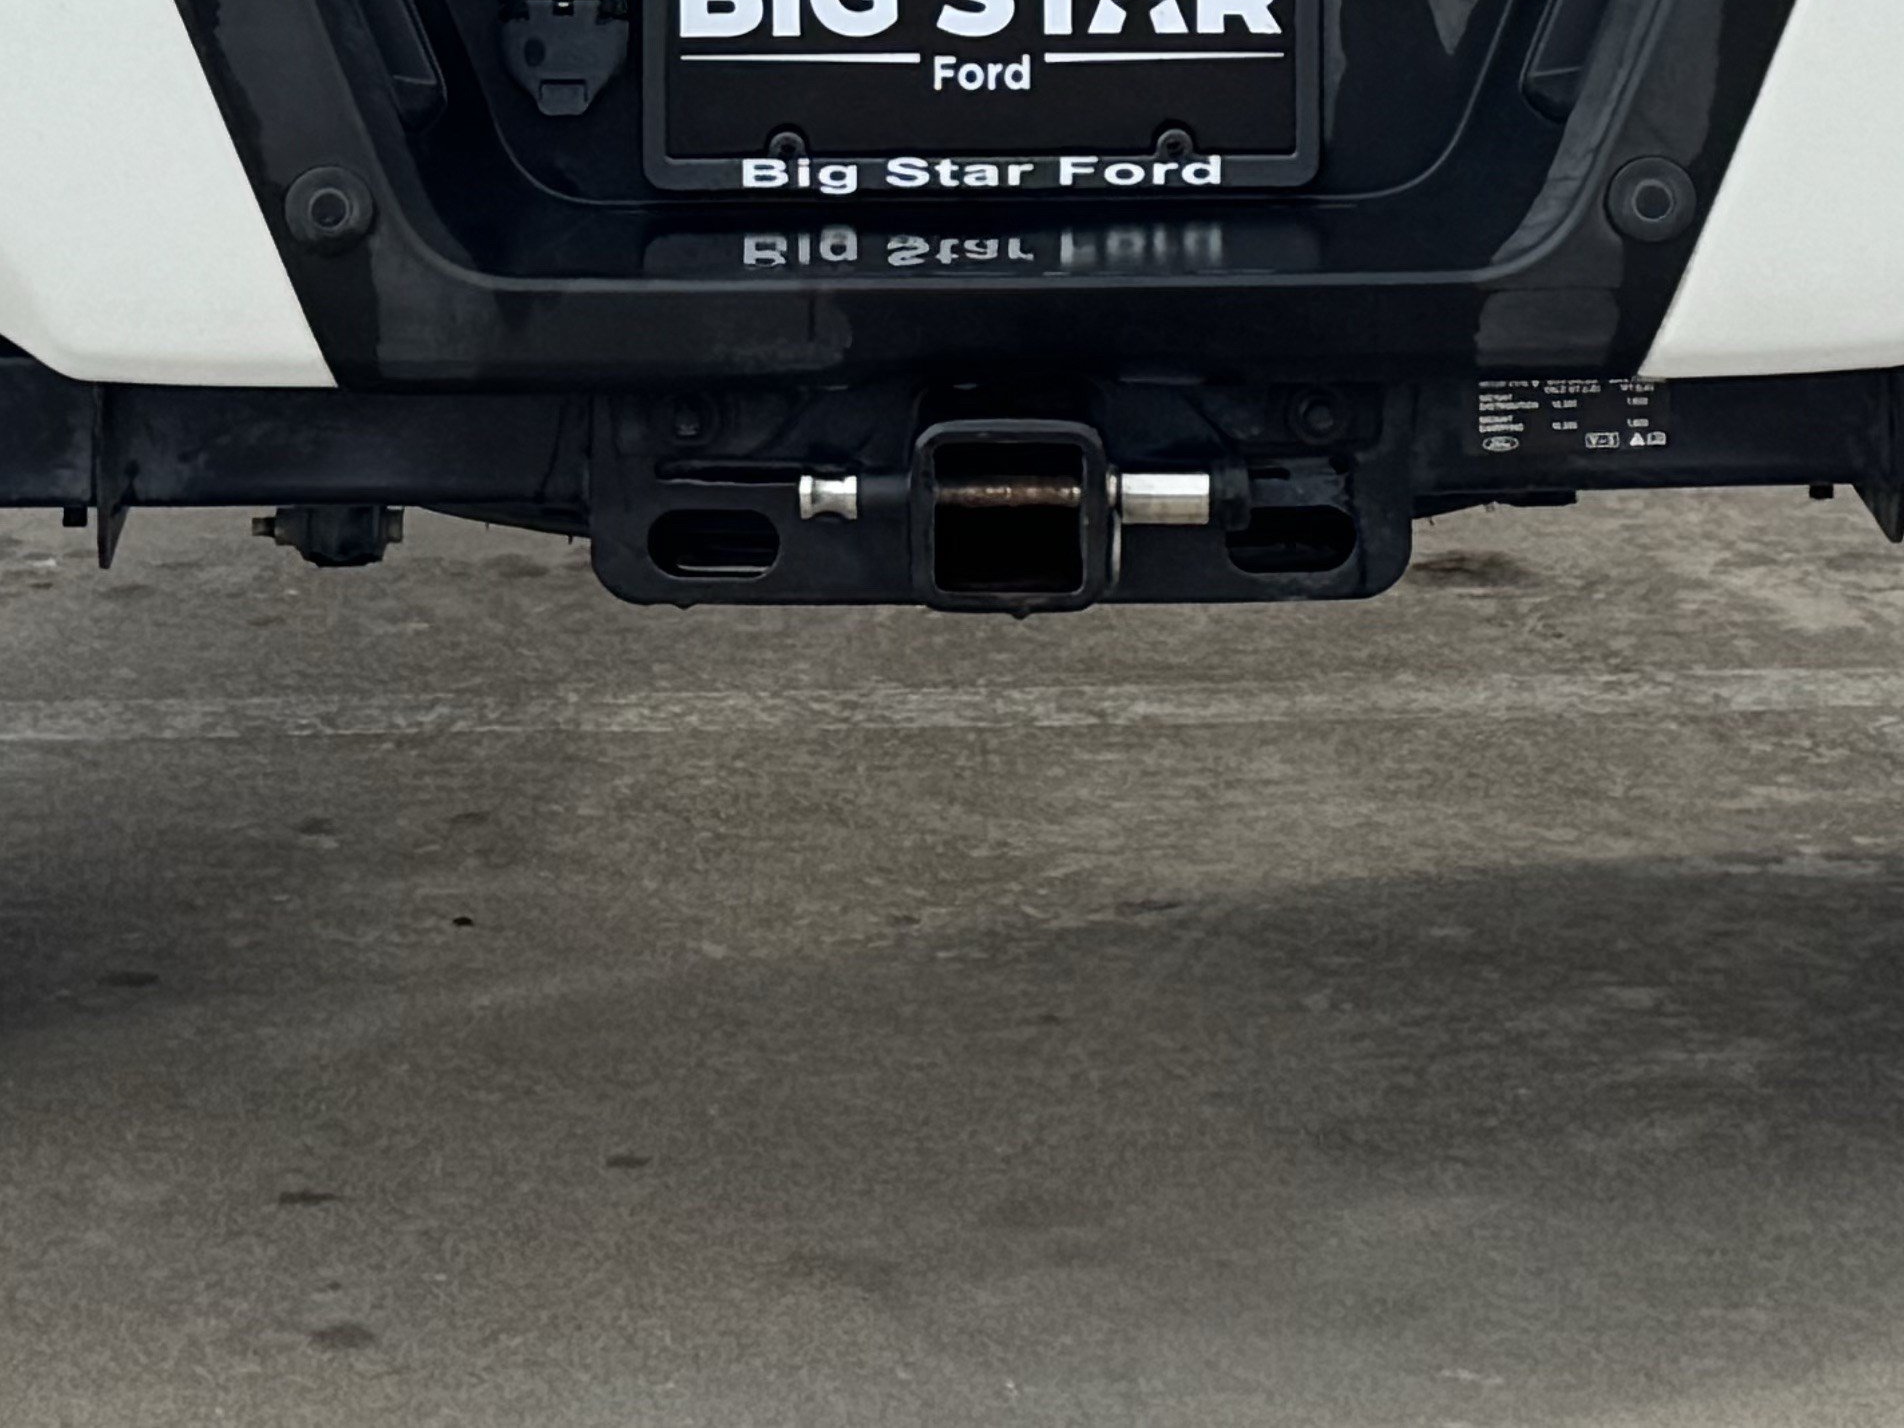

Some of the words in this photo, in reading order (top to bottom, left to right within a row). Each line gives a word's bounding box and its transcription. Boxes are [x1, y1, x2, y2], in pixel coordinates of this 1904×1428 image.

[933, 53, 1031, 91] Ford
[742, 157, 858, 195] Big
[886, 156, 1034, 188] Star
[1059, 154, 1222, 186] Ford
